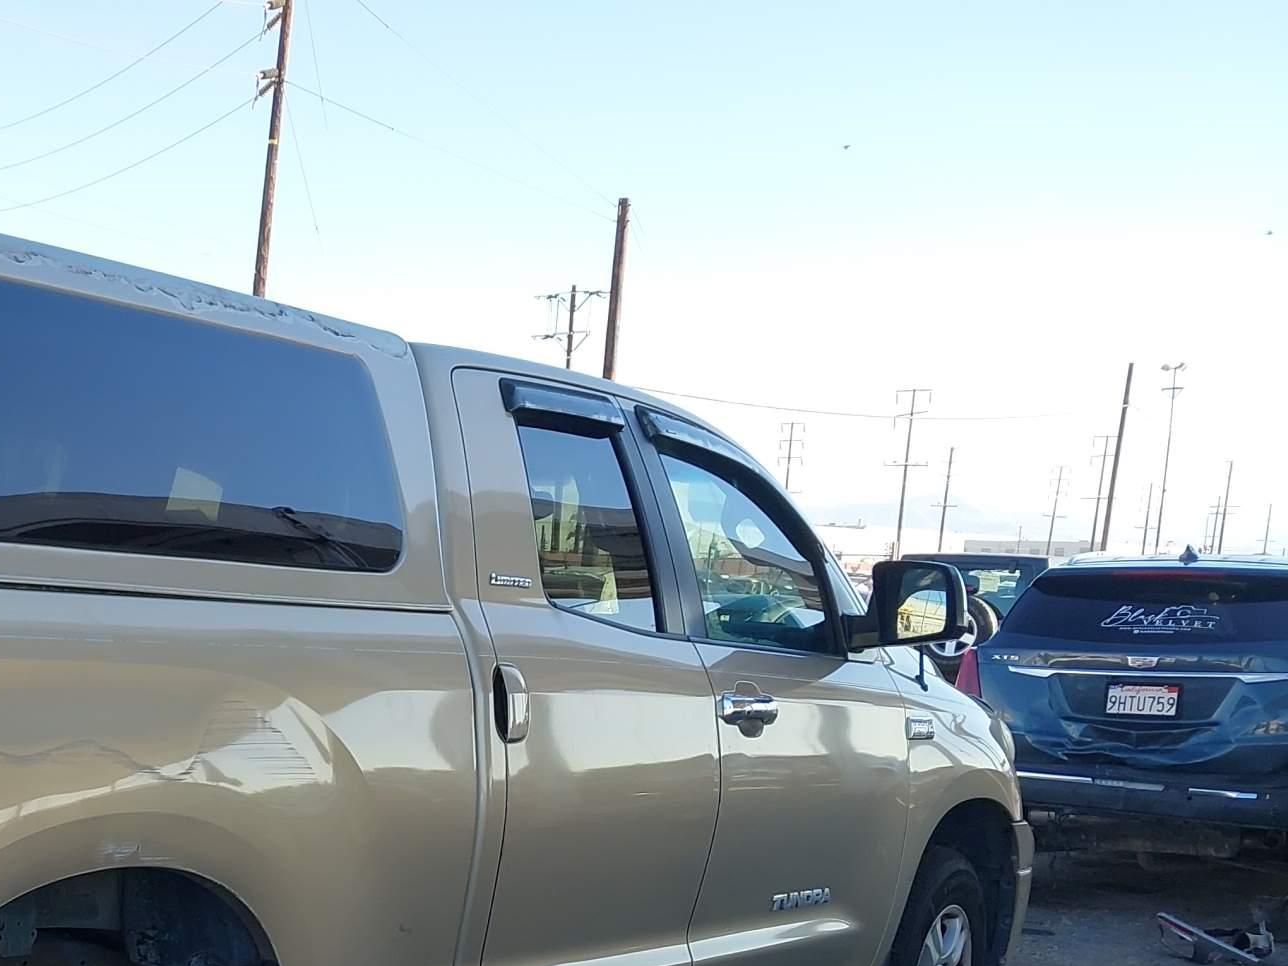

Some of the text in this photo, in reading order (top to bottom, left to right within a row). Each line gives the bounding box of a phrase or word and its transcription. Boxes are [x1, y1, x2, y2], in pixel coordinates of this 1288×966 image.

[1142, 619, 1216, 629] VELVET
[1107, 694, 1176, 713] 9HTU759
[772, 887, 831, 911] TUNDRA
